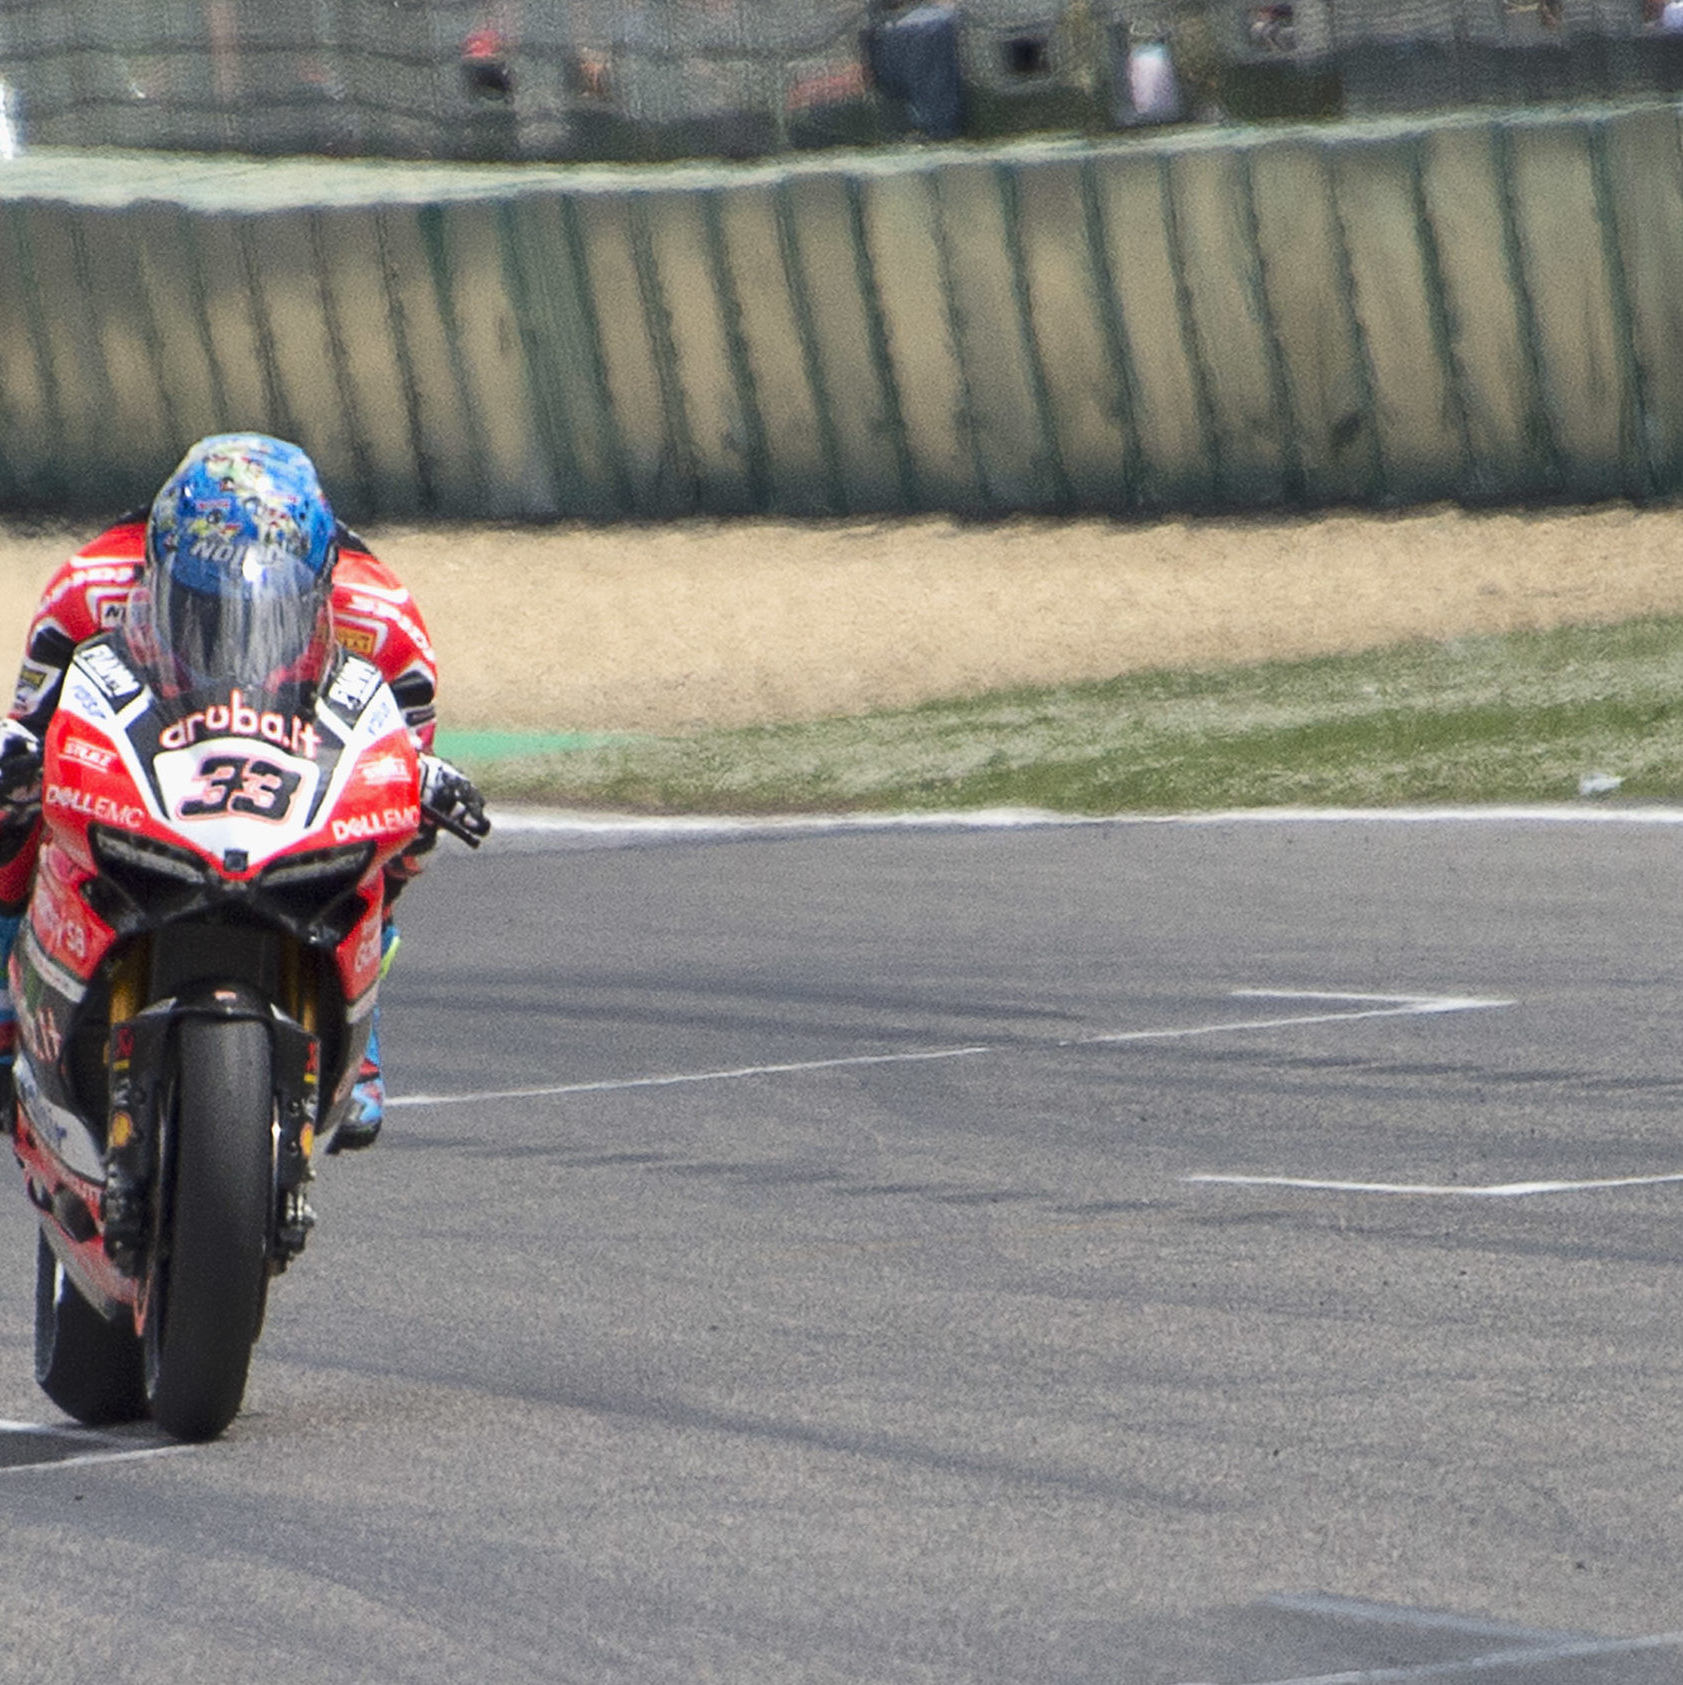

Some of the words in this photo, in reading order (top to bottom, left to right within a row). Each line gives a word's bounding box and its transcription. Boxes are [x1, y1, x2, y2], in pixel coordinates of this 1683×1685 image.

[189, 538, 287, 566] NOLN
[159, 687, 322, 759] aruba.it
[176, 753, 305, 825] 33
